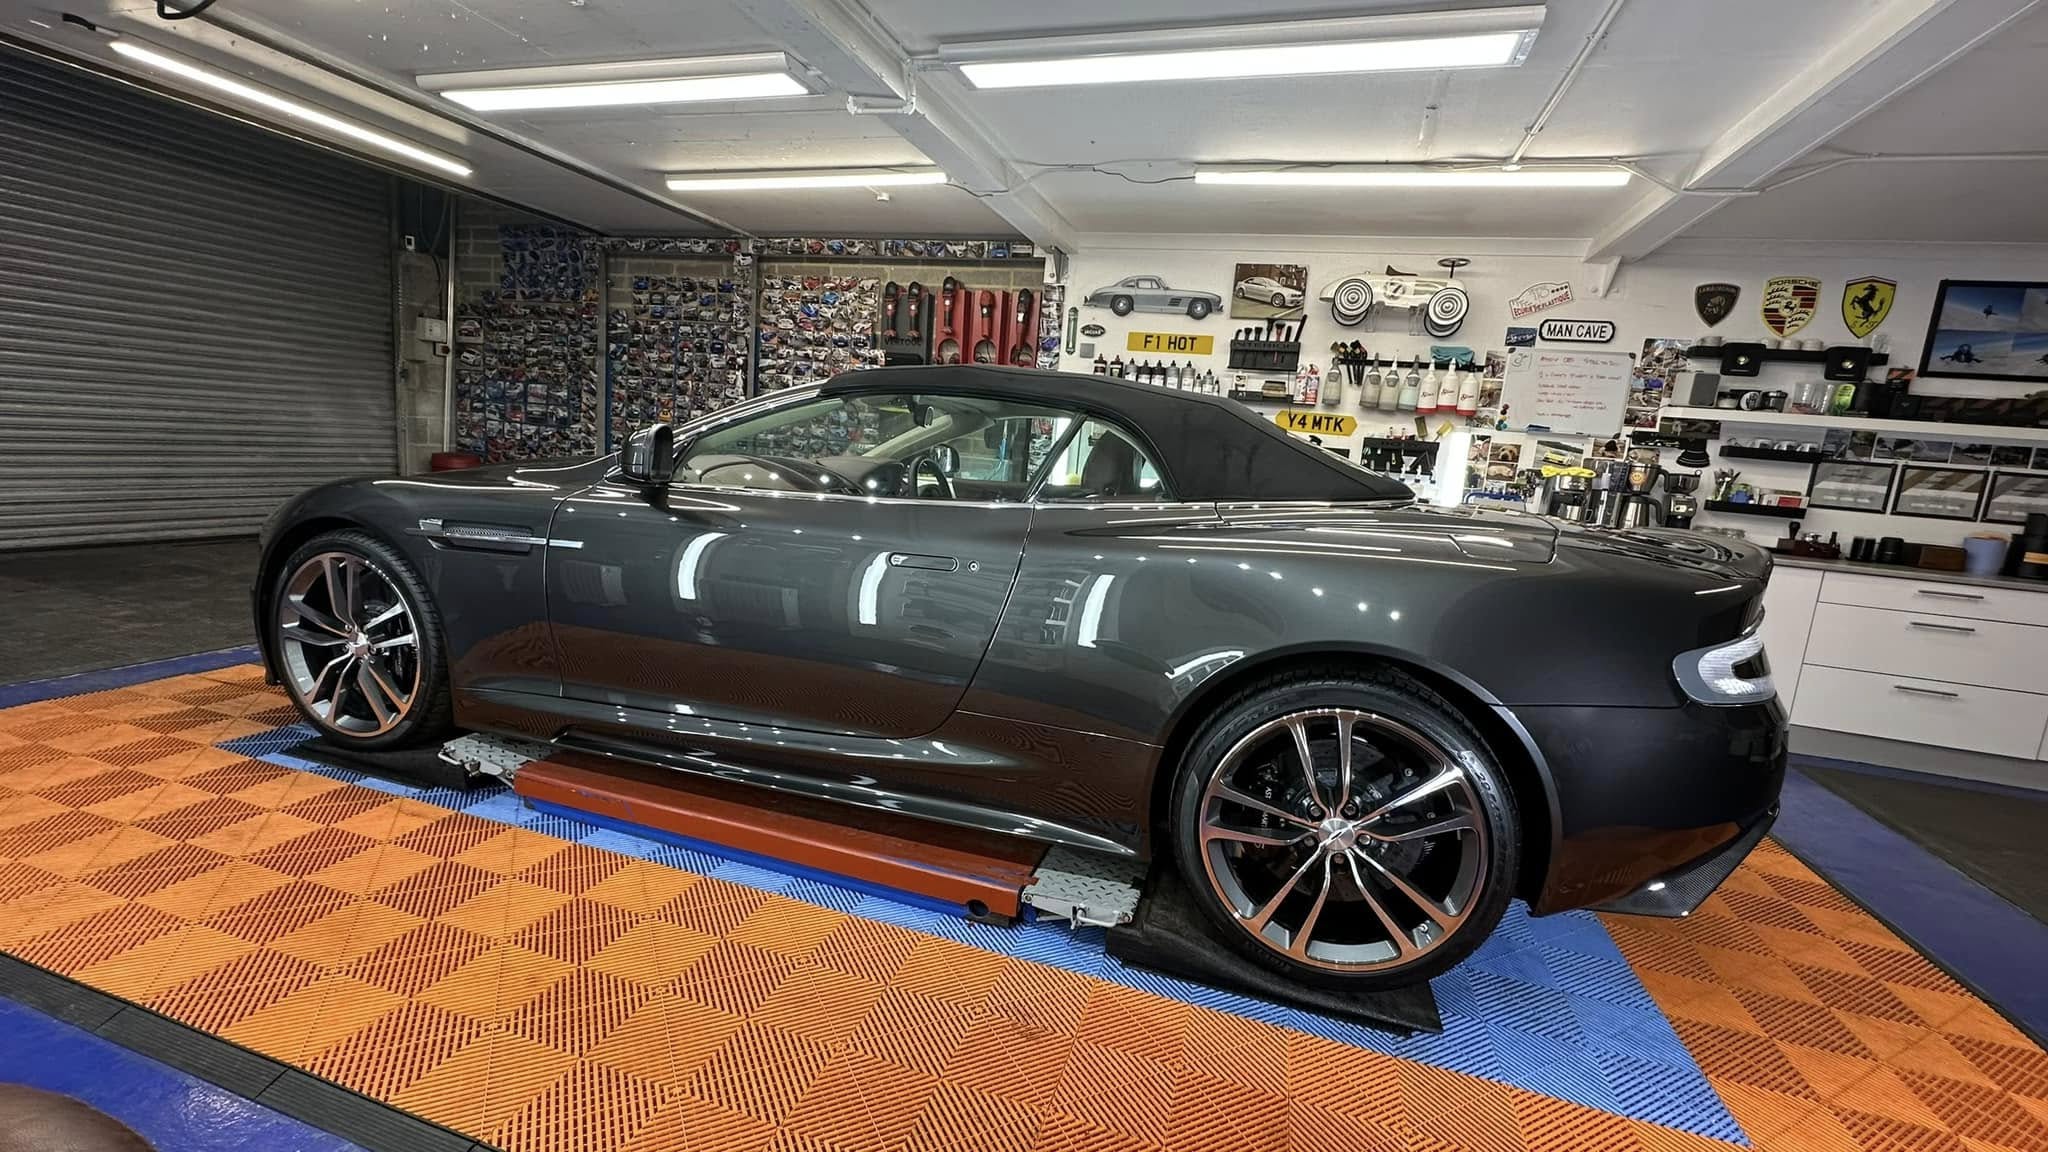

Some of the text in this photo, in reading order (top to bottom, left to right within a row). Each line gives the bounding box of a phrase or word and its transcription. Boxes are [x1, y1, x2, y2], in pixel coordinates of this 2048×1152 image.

[1768, 279, 1818, 287] PORSCHE
[1547, 323, 1608, 339] MAN CAVE
[1144, 335, 1198, 351] F1 HOT
[1288, 414, 1345, 433] Y4 MTK
